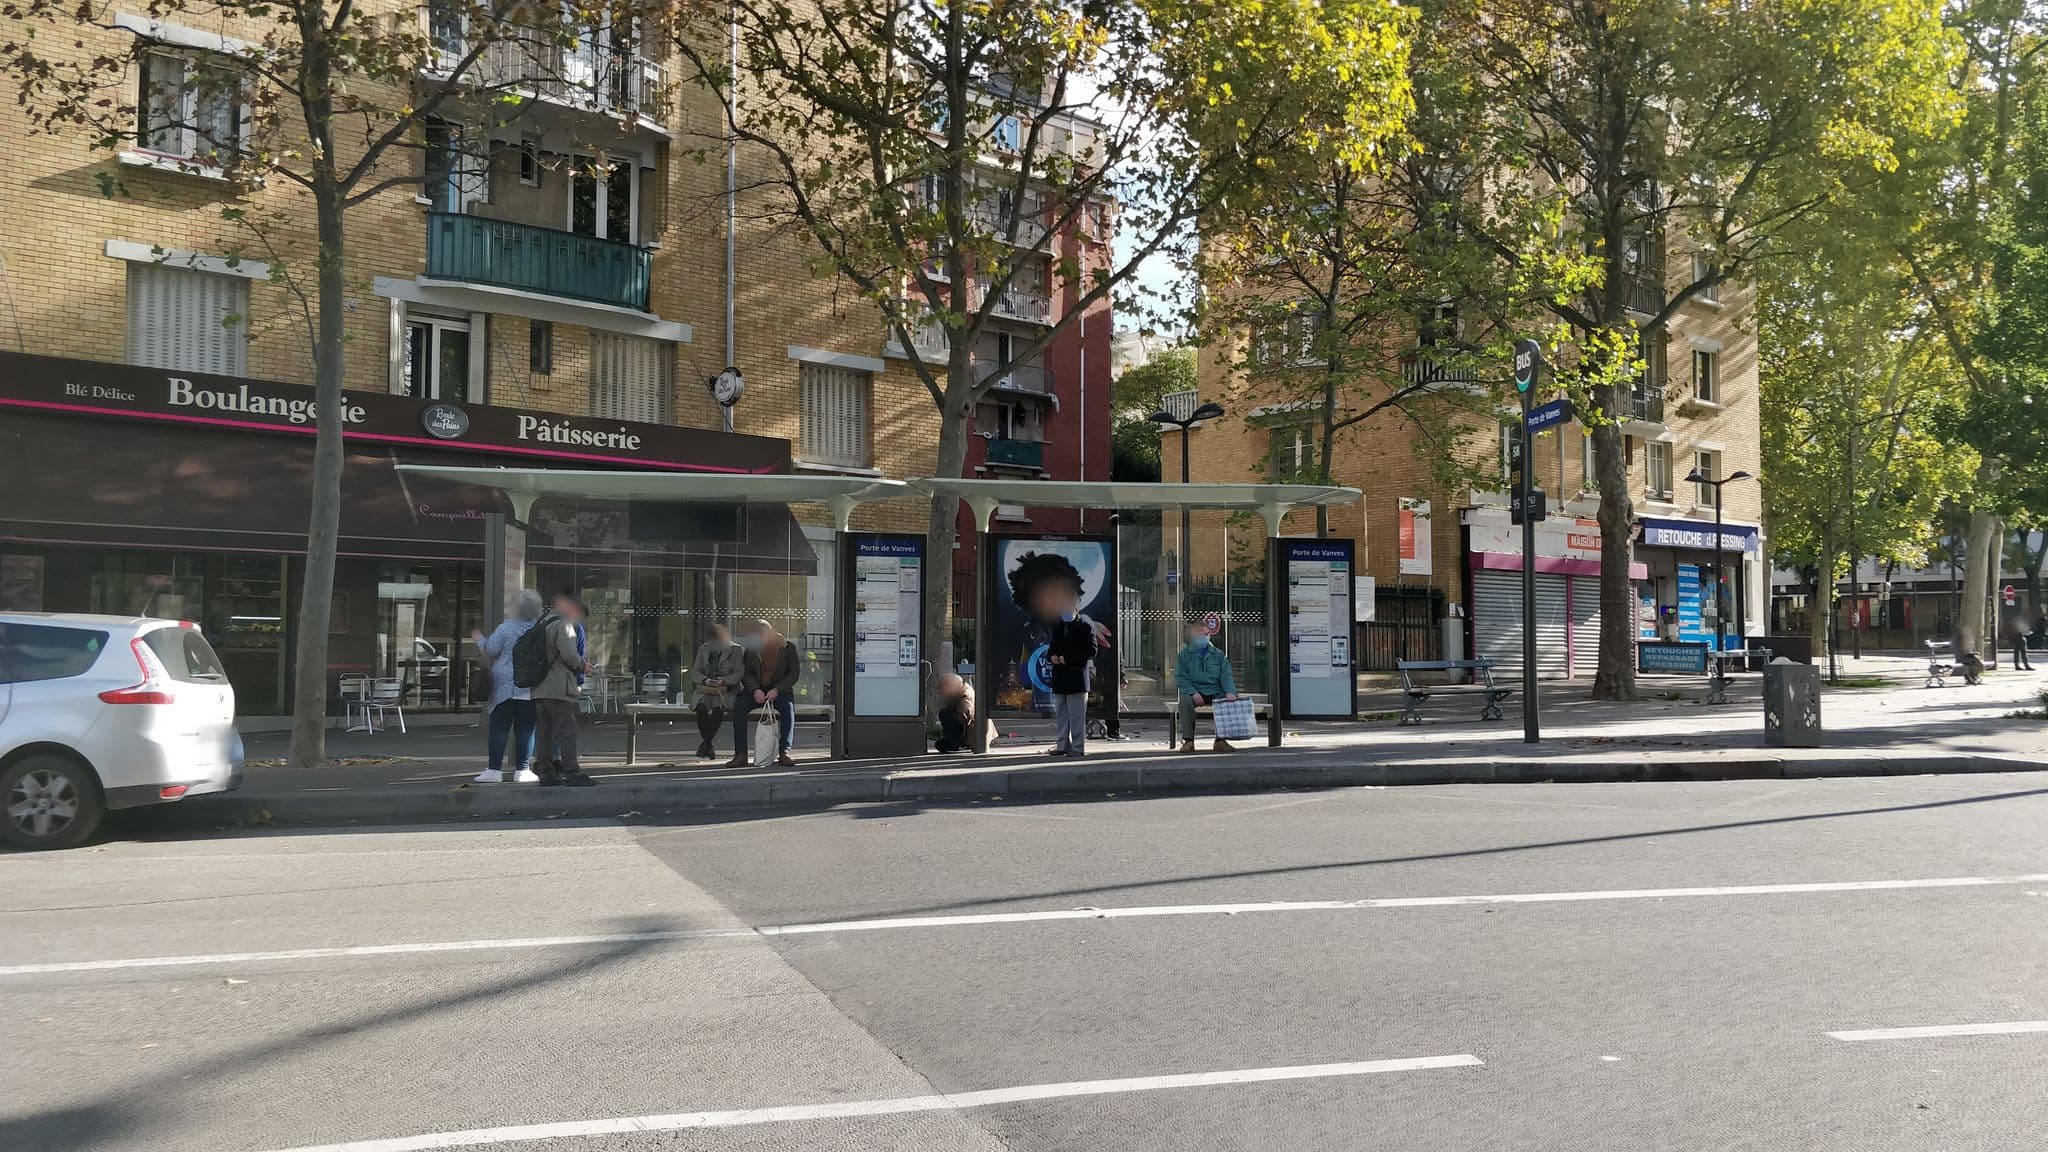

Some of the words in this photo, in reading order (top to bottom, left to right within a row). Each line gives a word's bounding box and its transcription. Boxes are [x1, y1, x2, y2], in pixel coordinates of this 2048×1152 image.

[1516, 351, 1531, 371] BUS
[65, 383, 88, 396] Blé
[93, 386, 136, 401] Délice
[168, 377, 366, 424] Boulangeie
[1528, 416, 1539, 427] Porte
[1540, 413, 1545, 422] de
[1546, 408, 1560, 420] Vanves
[442, 418, 460, 430] Pains
[517, 414, 641, 451] Pâtisserie
[1513, 446, 1520, 458] 58
[1571, 535, 1596, 548] MAISON
[1658, 529, 1702, 546] RETOUCHE
[1706, 532, 1746, 549] d.PESSING
[881, 544, 890, 552] de
[892, 545, 916, 553] Vanves
[1312, 549, 1320, 557] de
[1644, 647, 1701, 655] RETOUCHES
[1646, 654, 1700, 662] REPASSAGE
[1649, 661, 1696, 669] PRESSING
